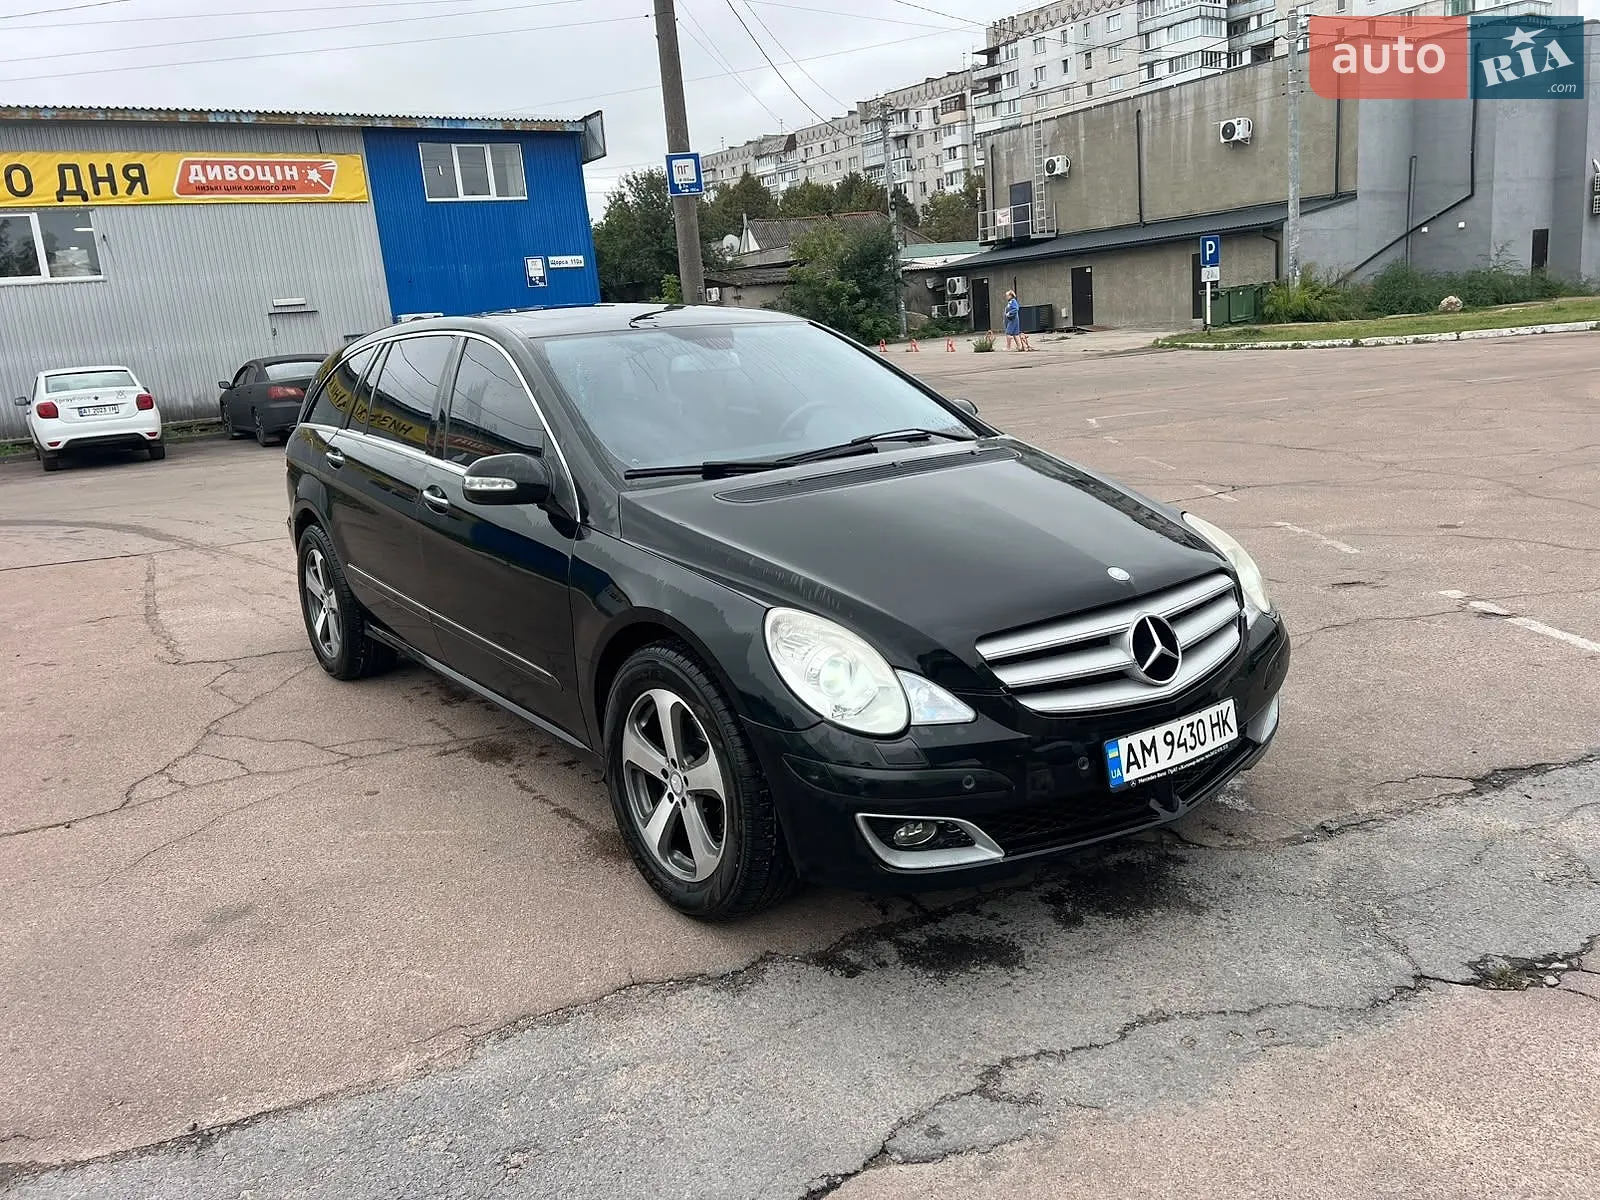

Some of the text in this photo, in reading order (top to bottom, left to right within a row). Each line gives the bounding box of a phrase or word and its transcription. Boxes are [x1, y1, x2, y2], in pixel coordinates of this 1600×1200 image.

[56, 163, 149, 202] ДНЯ
[188, 164, 299, 184] ДИВОЦІН
[1206, 240, 1216, 261] P
[1126, 735, 1159, 774] AM
[1163, 718, 1207, 761] 9430
[1209, 706, 1234, 742] HK
[1111, 767, 1122, 779] UA
